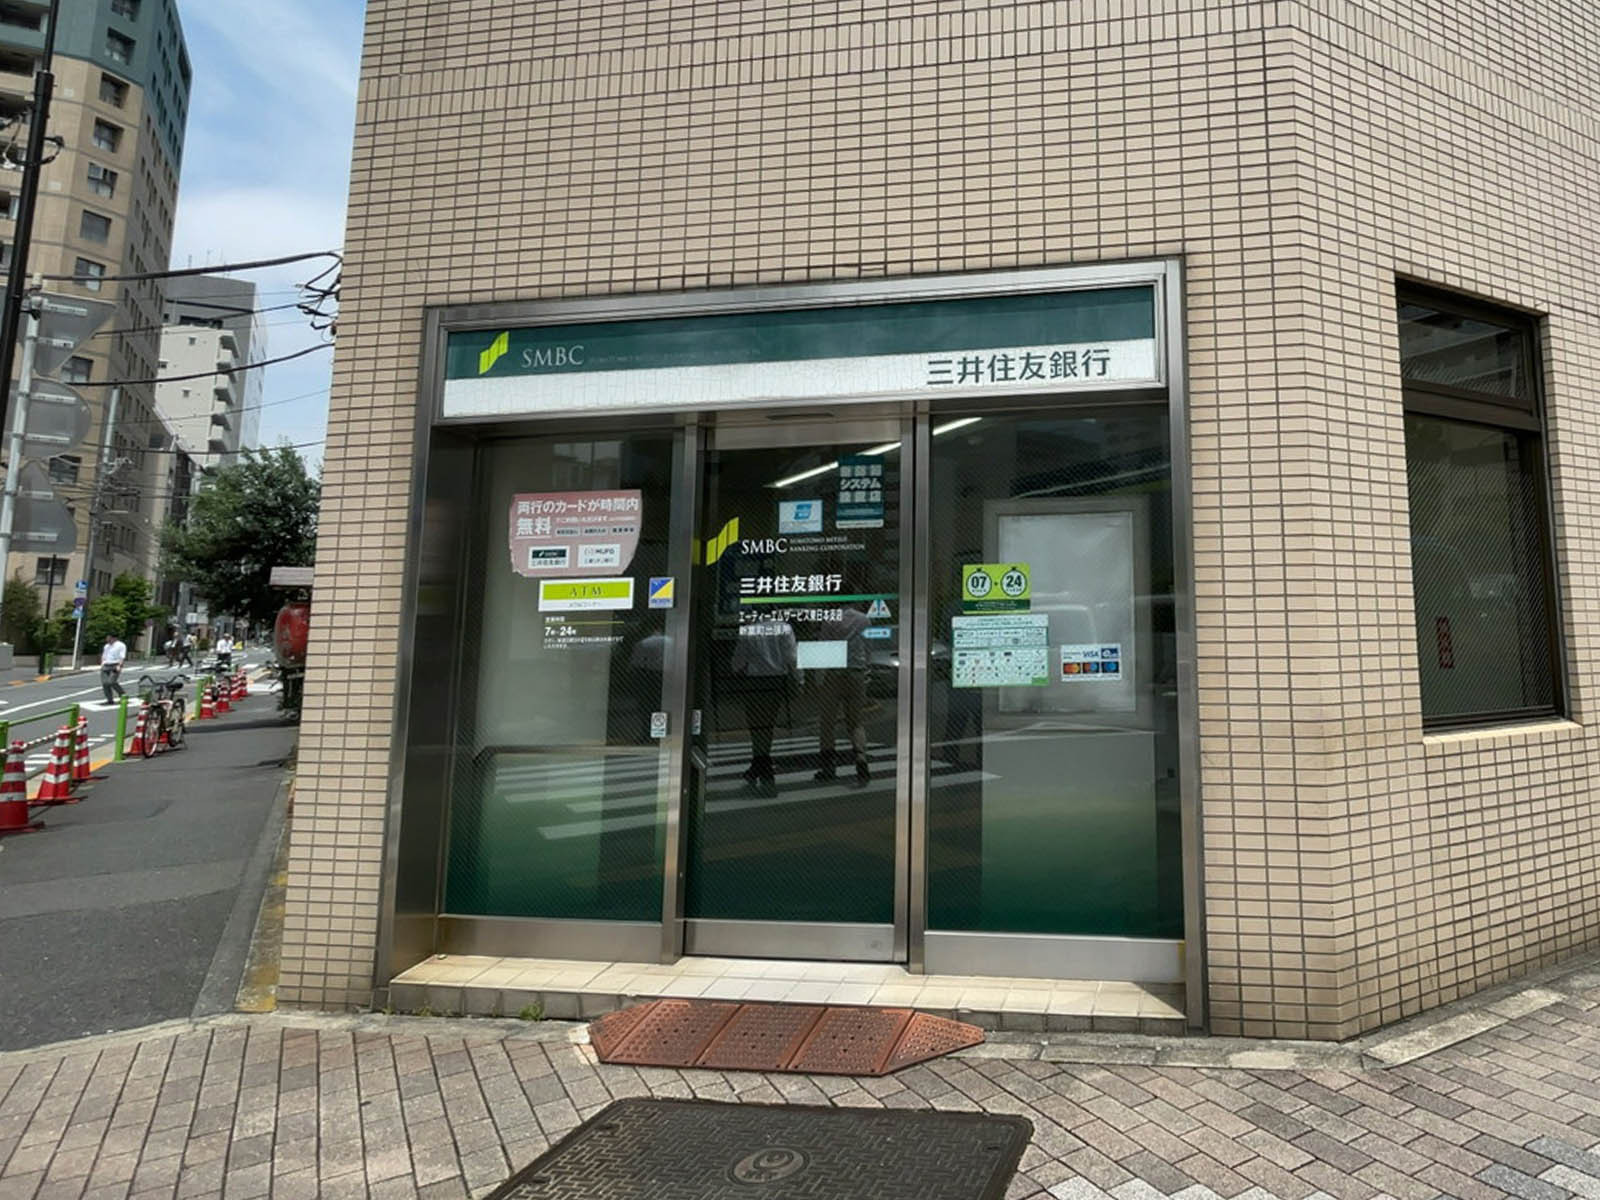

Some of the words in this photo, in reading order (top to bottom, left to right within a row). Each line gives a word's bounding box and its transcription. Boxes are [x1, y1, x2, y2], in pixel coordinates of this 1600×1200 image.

[521, 345, 585, 369] SMBC
[926, 348, 1111, 386] 三井住友銀行
[840, 478, 882, 490] システム
[517, 497, 640, 515] 両行のカードが時間内
[516, 516, 551, 537] 無料
[740, 537, 788, 555] SMBC
[739, 574, 843, 595] 三井住友銀行
[971, 576, 988, 589] 07
[1006, 575, 1023, 588] 24
[570, 587, 603, 597] ATM
[1083, 650, 1100, 659] VISA
